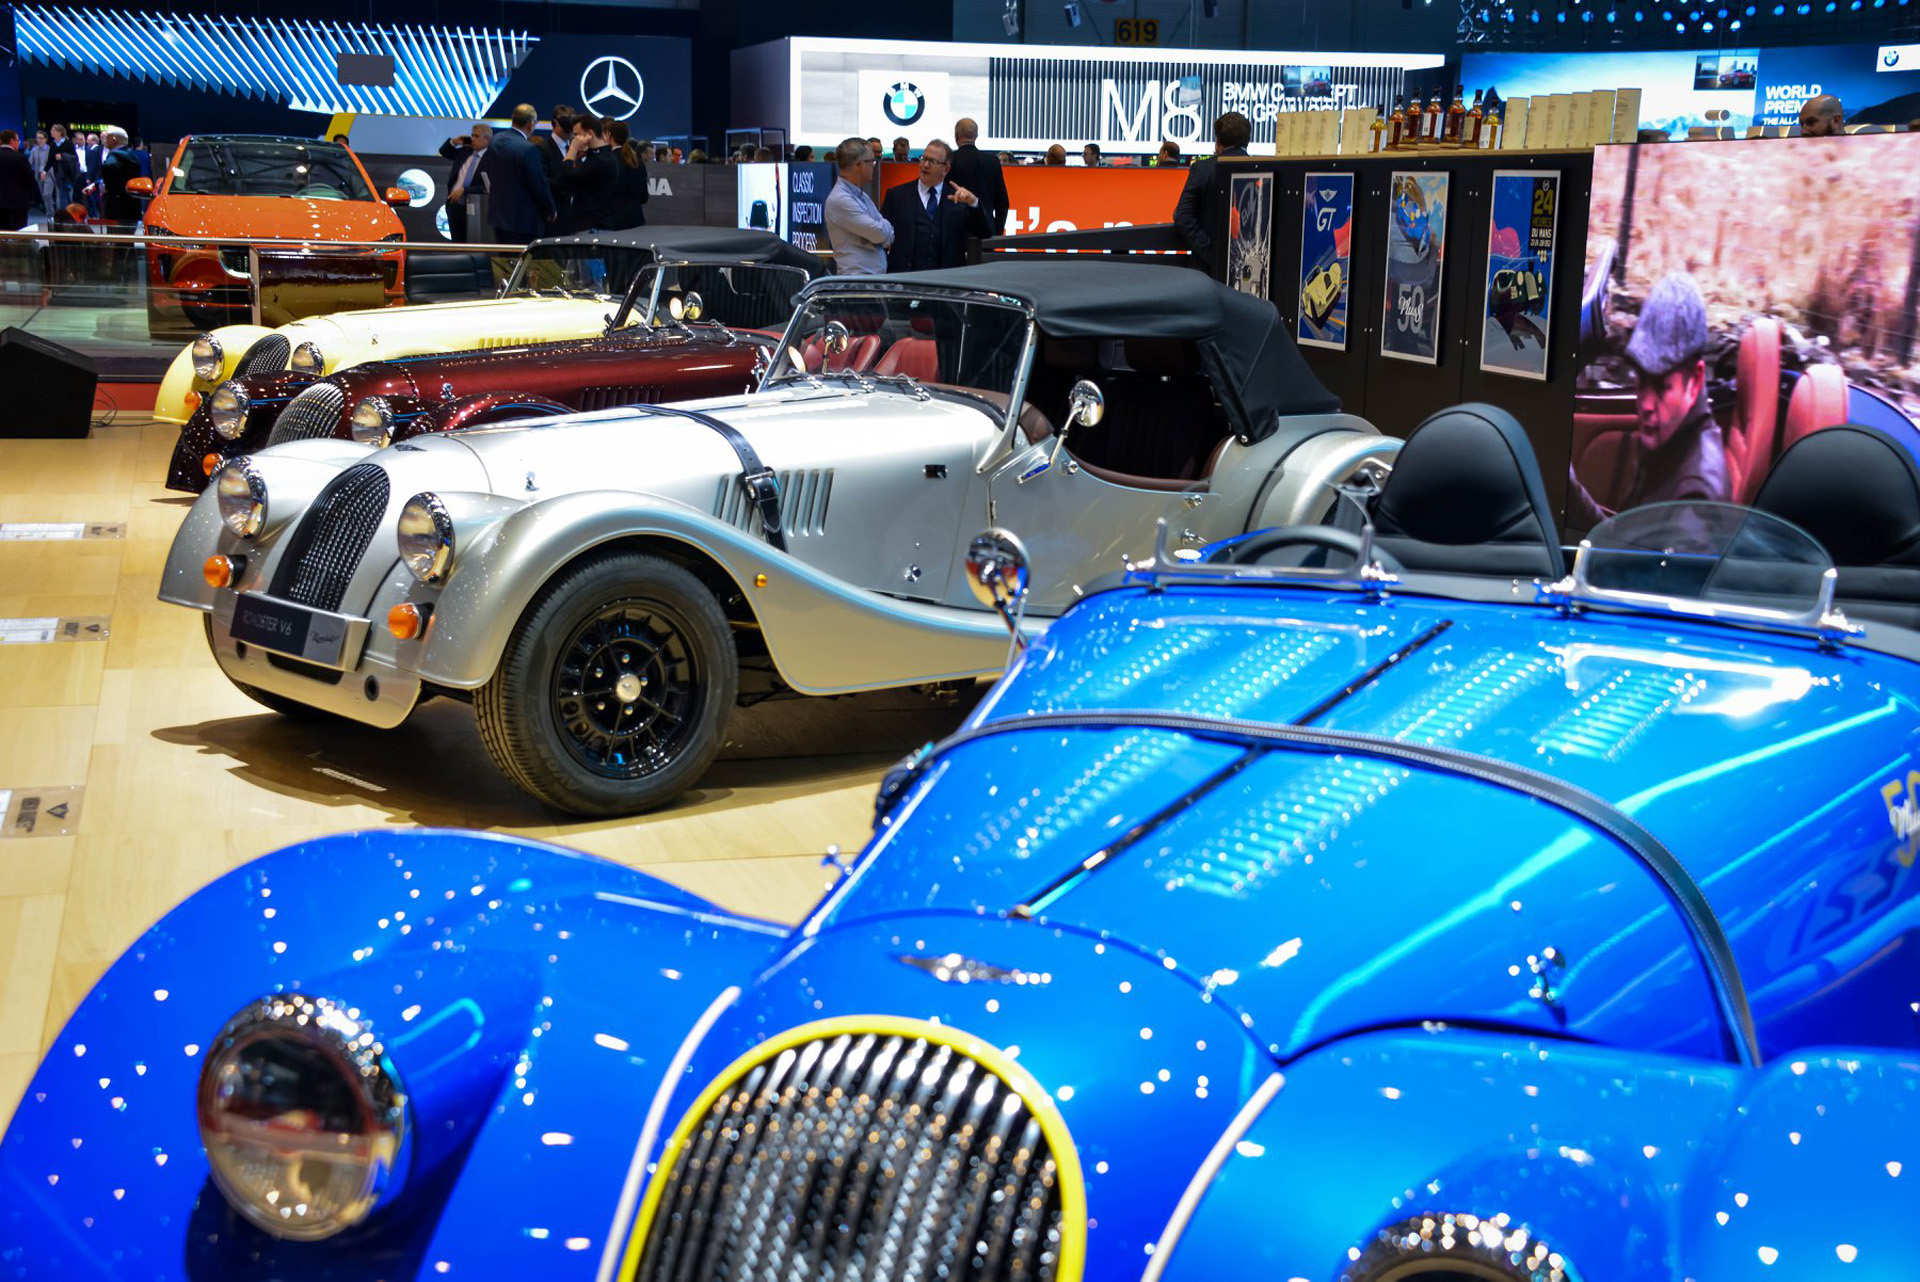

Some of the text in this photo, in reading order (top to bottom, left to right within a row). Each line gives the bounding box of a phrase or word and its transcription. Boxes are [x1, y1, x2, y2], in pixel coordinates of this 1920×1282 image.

[1118, 21, 1157, 42] 619
[1222, 81, 1269, 101] BMW
[1765, 84, 1822, 99] WORLD
[1101, 78, 1202, 143] M8
[792, 171, 814, 194] CLASSIC
[792, 201, 823, 224] INSPECTION
[1533, 189, 1554, 215] 24
[1316, 207, 1337, 232] GT
[1531, 227, 1539, 238] DU
[279, 619, 293, 636] V6
